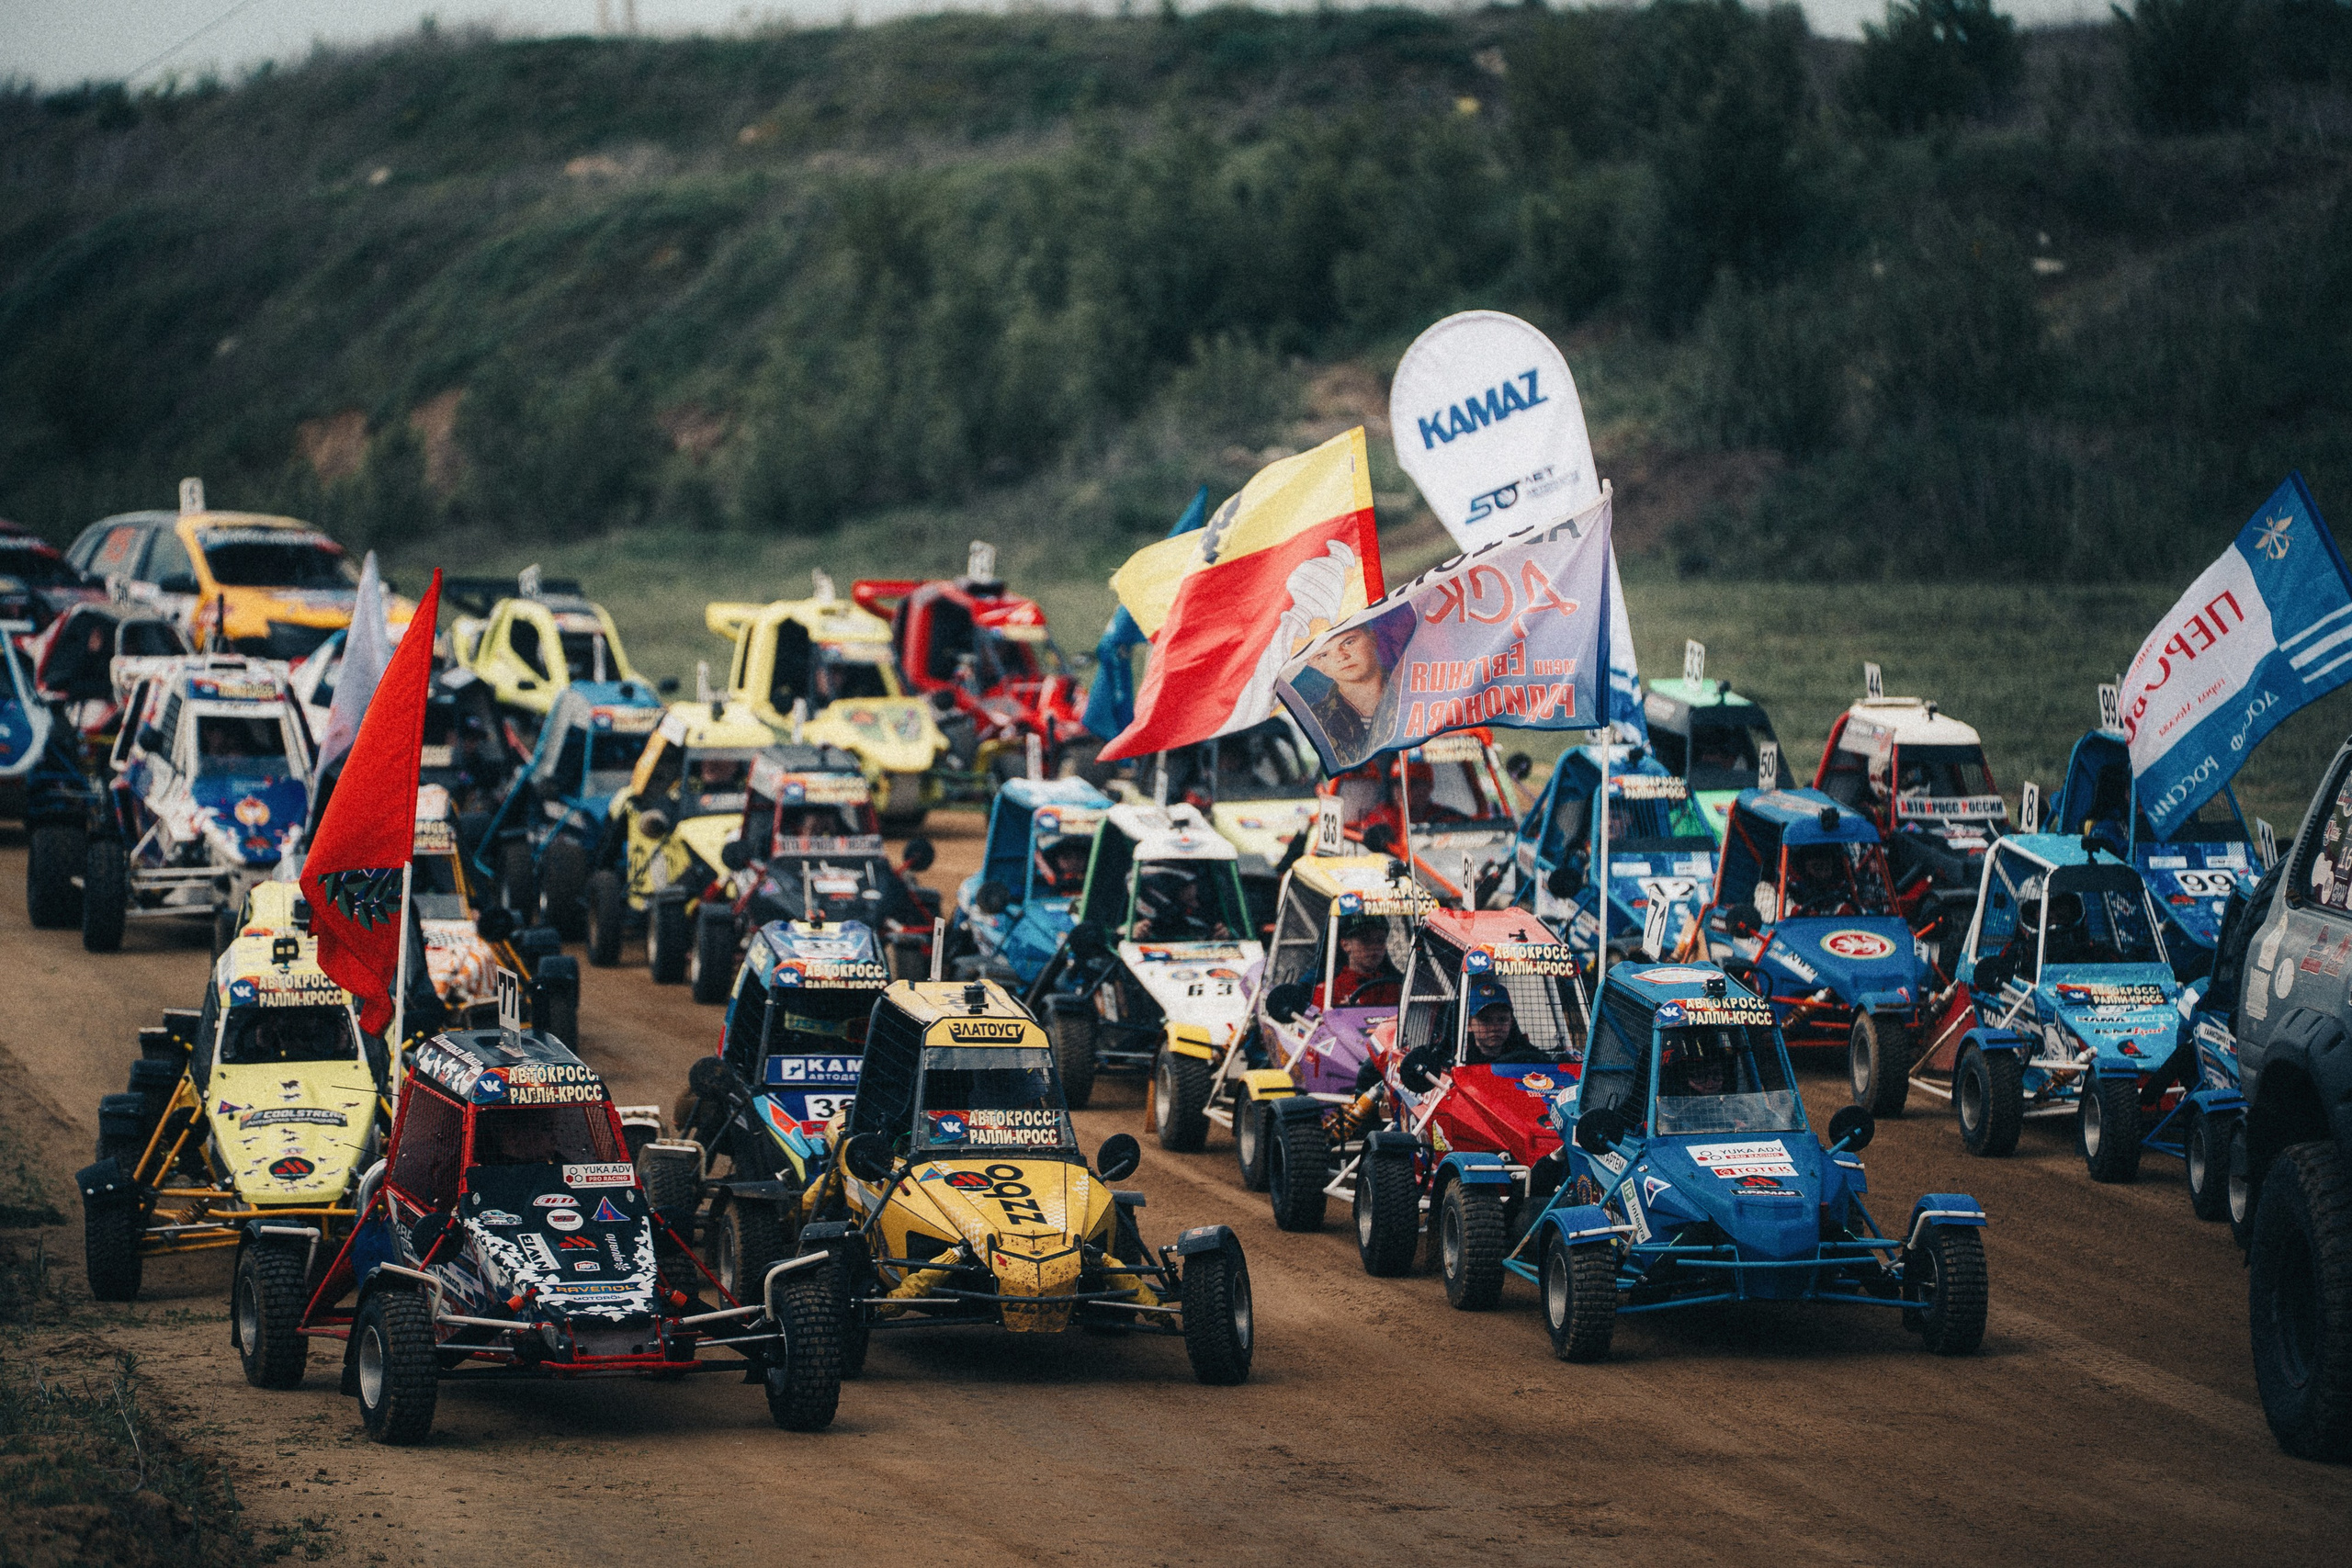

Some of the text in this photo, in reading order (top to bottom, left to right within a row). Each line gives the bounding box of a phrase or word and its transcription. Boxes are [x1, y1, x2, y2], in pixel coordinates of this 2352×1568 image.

[1418, 367, 1548, 449] KAMAZ
[2102, 688, 2117, 725] 99
[1760, 751, 1775, 778] 50
[1962, 799, 2003, 814] РОССИИ
[2027, 789, 2035, 827] 8
[1323, 813, 1338, 845] 33
[1647, 898, 1666, 945] 71
[1495, 960, 1573, 976] РАЛЛИ-КРОСС
[258, 990, 342, 1008] РАЛЛИ-КРОСС
[1688, 1010, 1772, 1025] РАЛЛИ-КРОСС
[953, 1022, 1023, 1038] ЗЛАТОУСТ
[510, 1085, 603, 1104] РАЛЛИ-КРОСС
[969, 1129, 1057, 1145] РАЛЛИ-КРОСС
[582, 1165, 631, 1174] YUKA ADV
[1631, 1204, 1646, 1241] integra
[605, 1233, 627, 1263] aquario
[555, 1284, 635, 1293] RAVENOL
